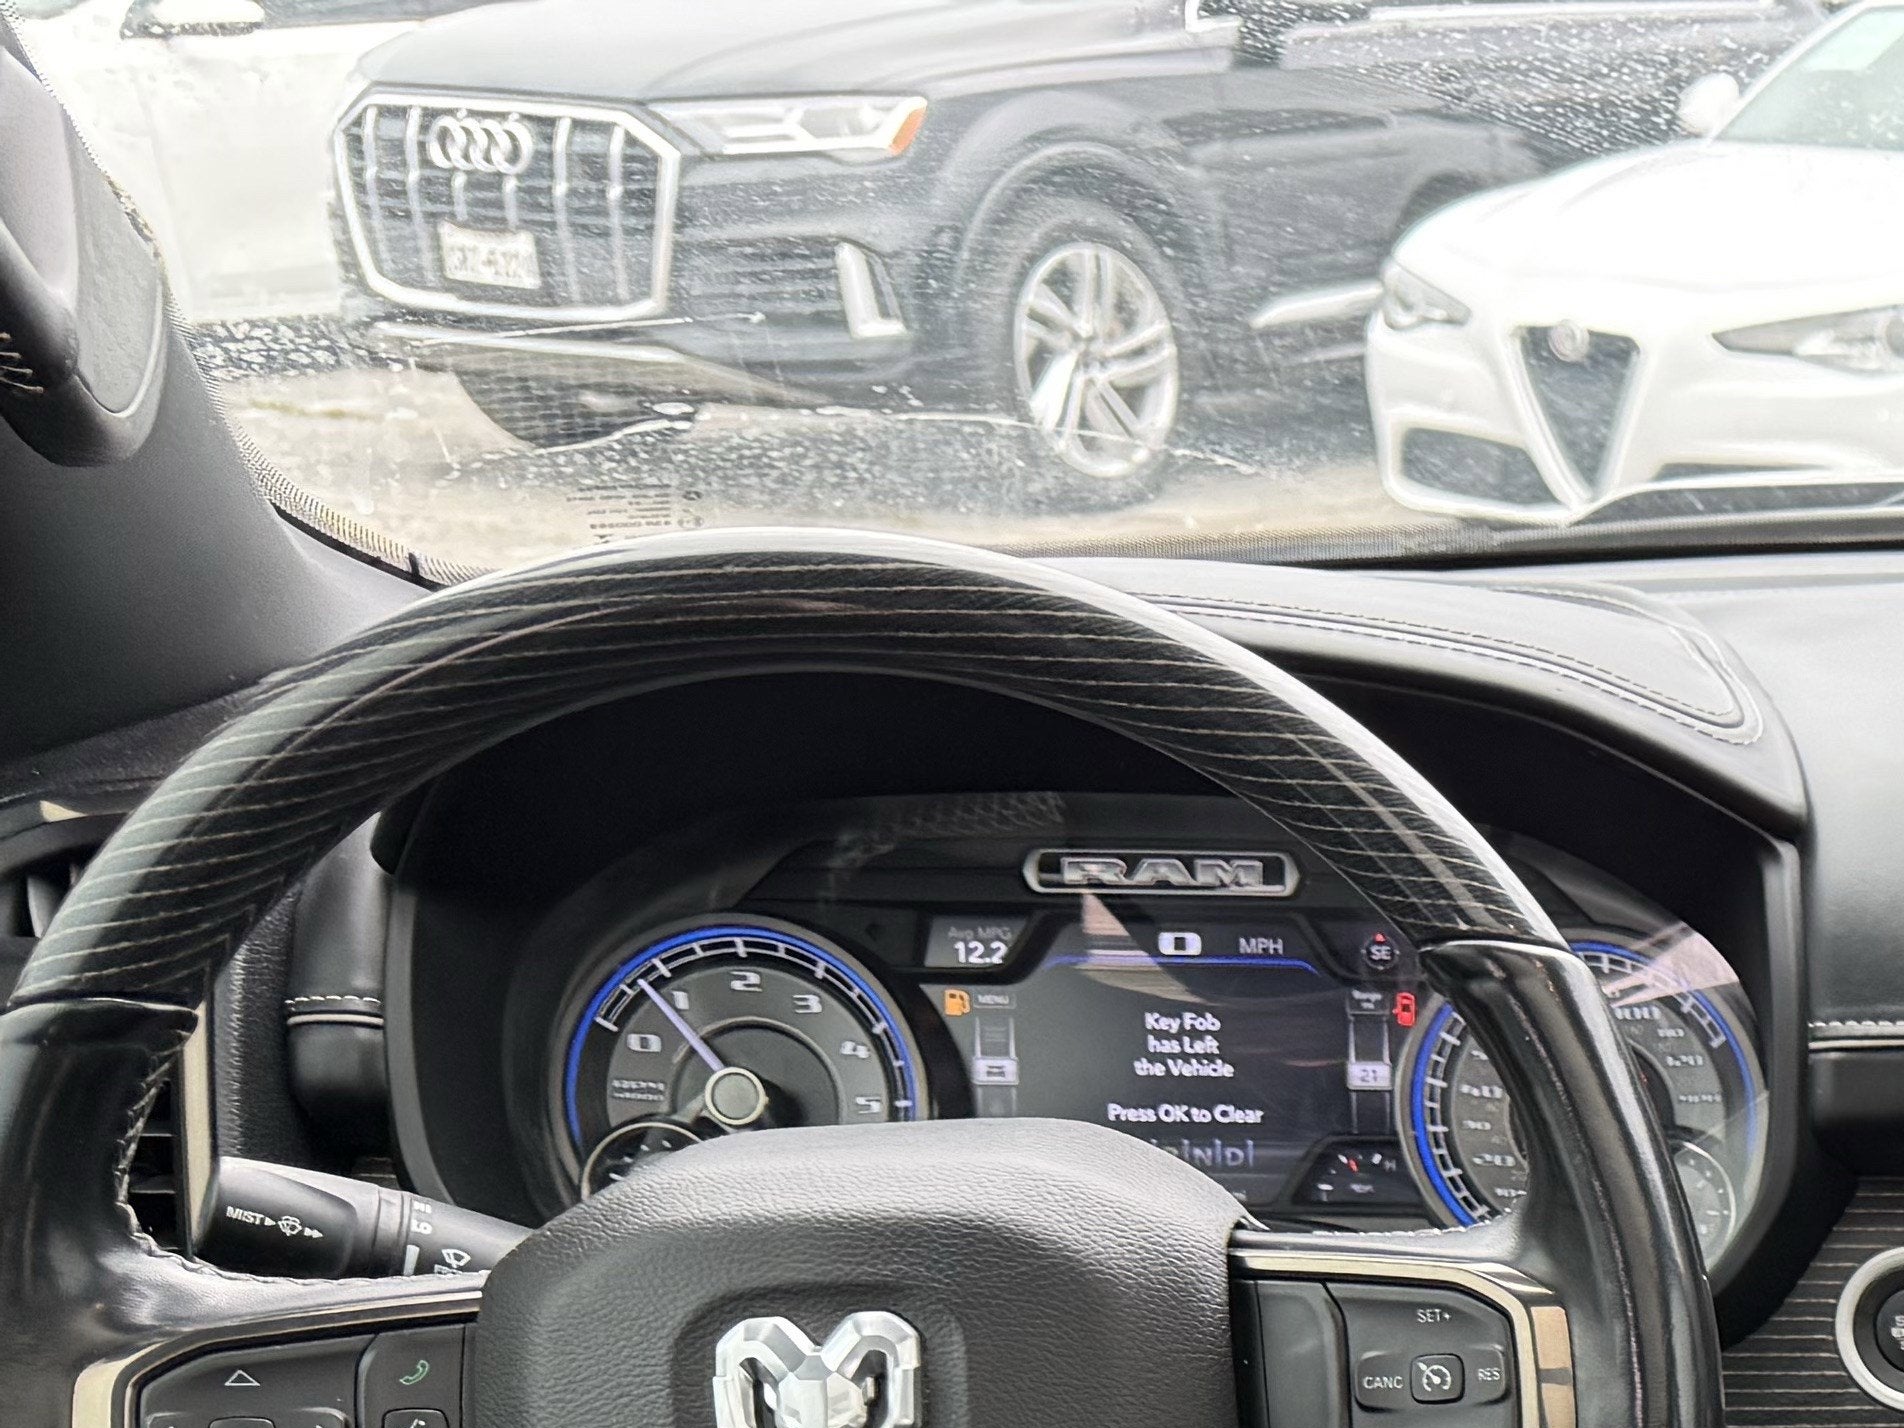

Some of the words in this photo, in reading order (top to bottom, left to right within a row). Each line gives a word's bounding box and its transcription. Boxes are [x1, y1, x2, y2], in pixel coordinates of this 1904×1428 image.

[1060, 857, 1263, 888] RAM
[954, 941, 1008, 964] 12.2
[1239, 937, 1283, 956] MPH
[1370, 946, 1391, 960] SE
[729, 970, 763, 992] 2
[671, 990, 690, 1010] 1
[792, 993, 824, 1014] 3
[1144, 1012, 1180, 1033] Key
[1183, 1013, 1221, 1031] Fob
[627, 1033, 662, 1053] 0
[840, 1041, 870, 1059] 4
[1147, 1035, 1181, 1053] has
[1183, 1036, 1220, 1054] Left
[1134, 1058, 1164, 1076] the
[1166, 1059, 1235, 1077] Vehicle
[855, 1096, 882, 1114] 5
[1107, 1103, 1156, 1122] Press
[1158, 1104, 1190, 1123] OK
[1190, 1107, 1211, 1123] to
[1213, 1104, 1264, 1123] Clear
[226, 1205, 265, 1225] MIST
[411, 1218, 433, 1235] LO
[1363, 1374, 1403, 1390] CANC
[1477, 1367, 1501, 1383] RES
